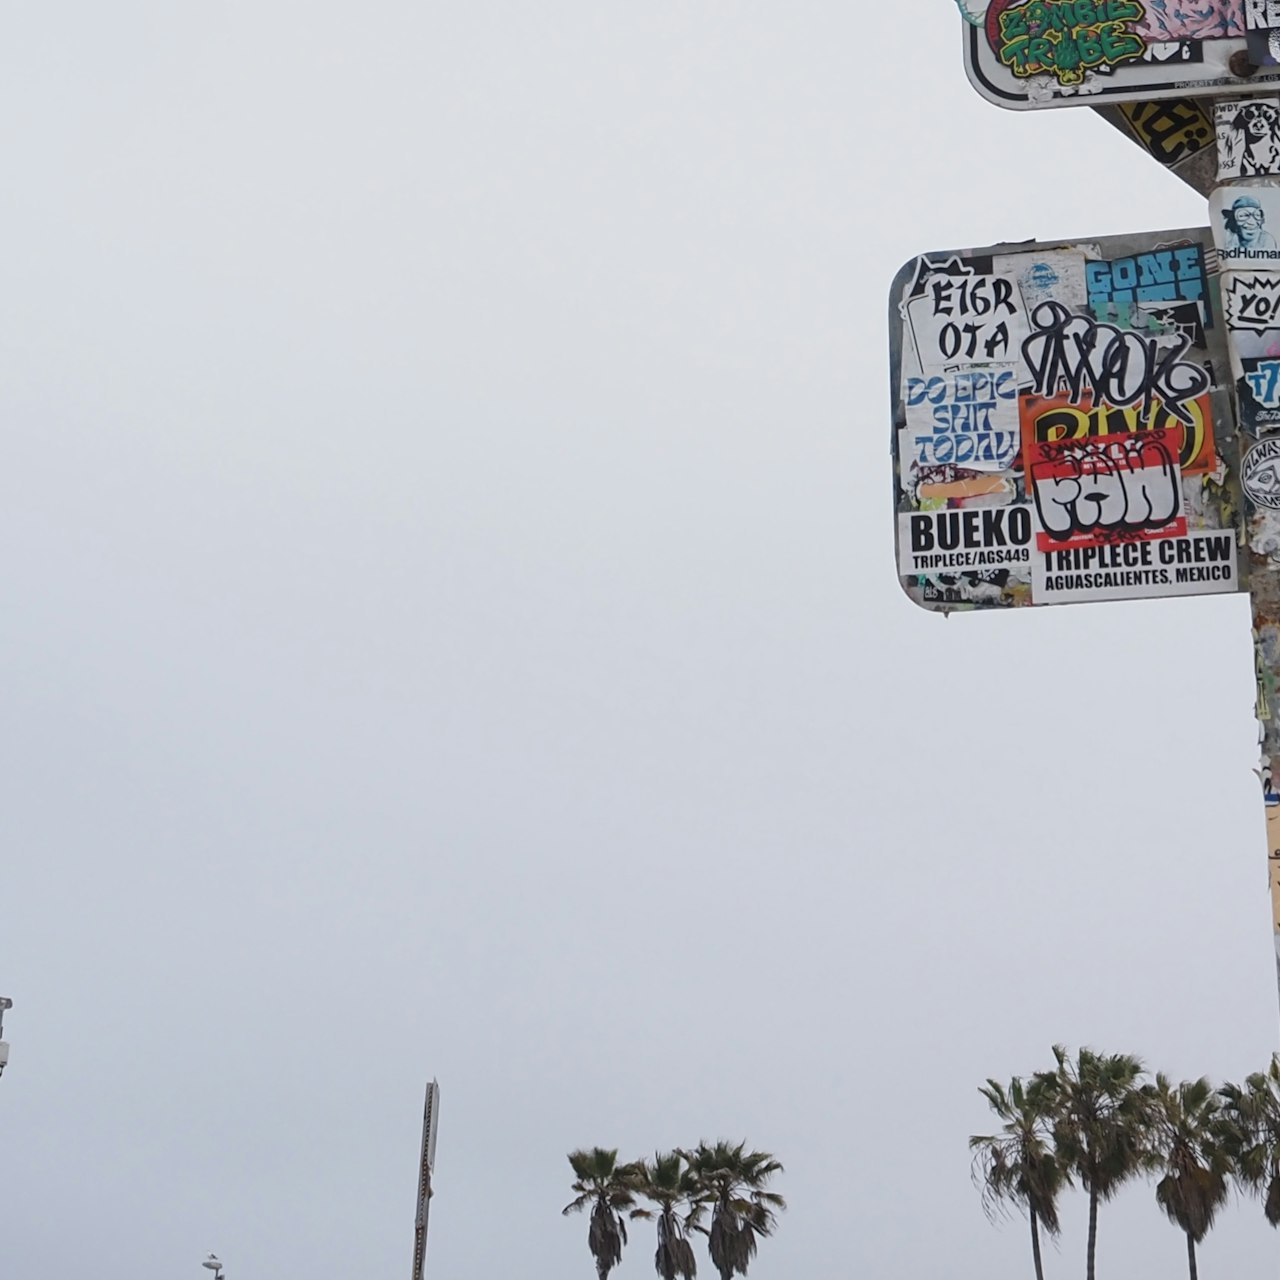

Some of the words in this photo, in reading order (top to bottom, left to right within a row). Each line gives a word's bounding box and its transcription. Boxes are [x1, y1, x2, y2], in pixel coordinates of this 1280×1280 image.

[1086, 247, 1202, 293] GONE
[938, 320, 1009, 360] OTA
[955, 371, 1017, 402] EPIC
[933, 402, 997, 434] SHIT
[915, 431, 1016, 463] TODAY
[910, 507, 1032, 553] BUEKO
[912, 547, 1030, 570] TRIPLECE/AGS449
[1158, 536, 1231, 566] CREW
[1175, 564, 1232, 584] MEXICO
